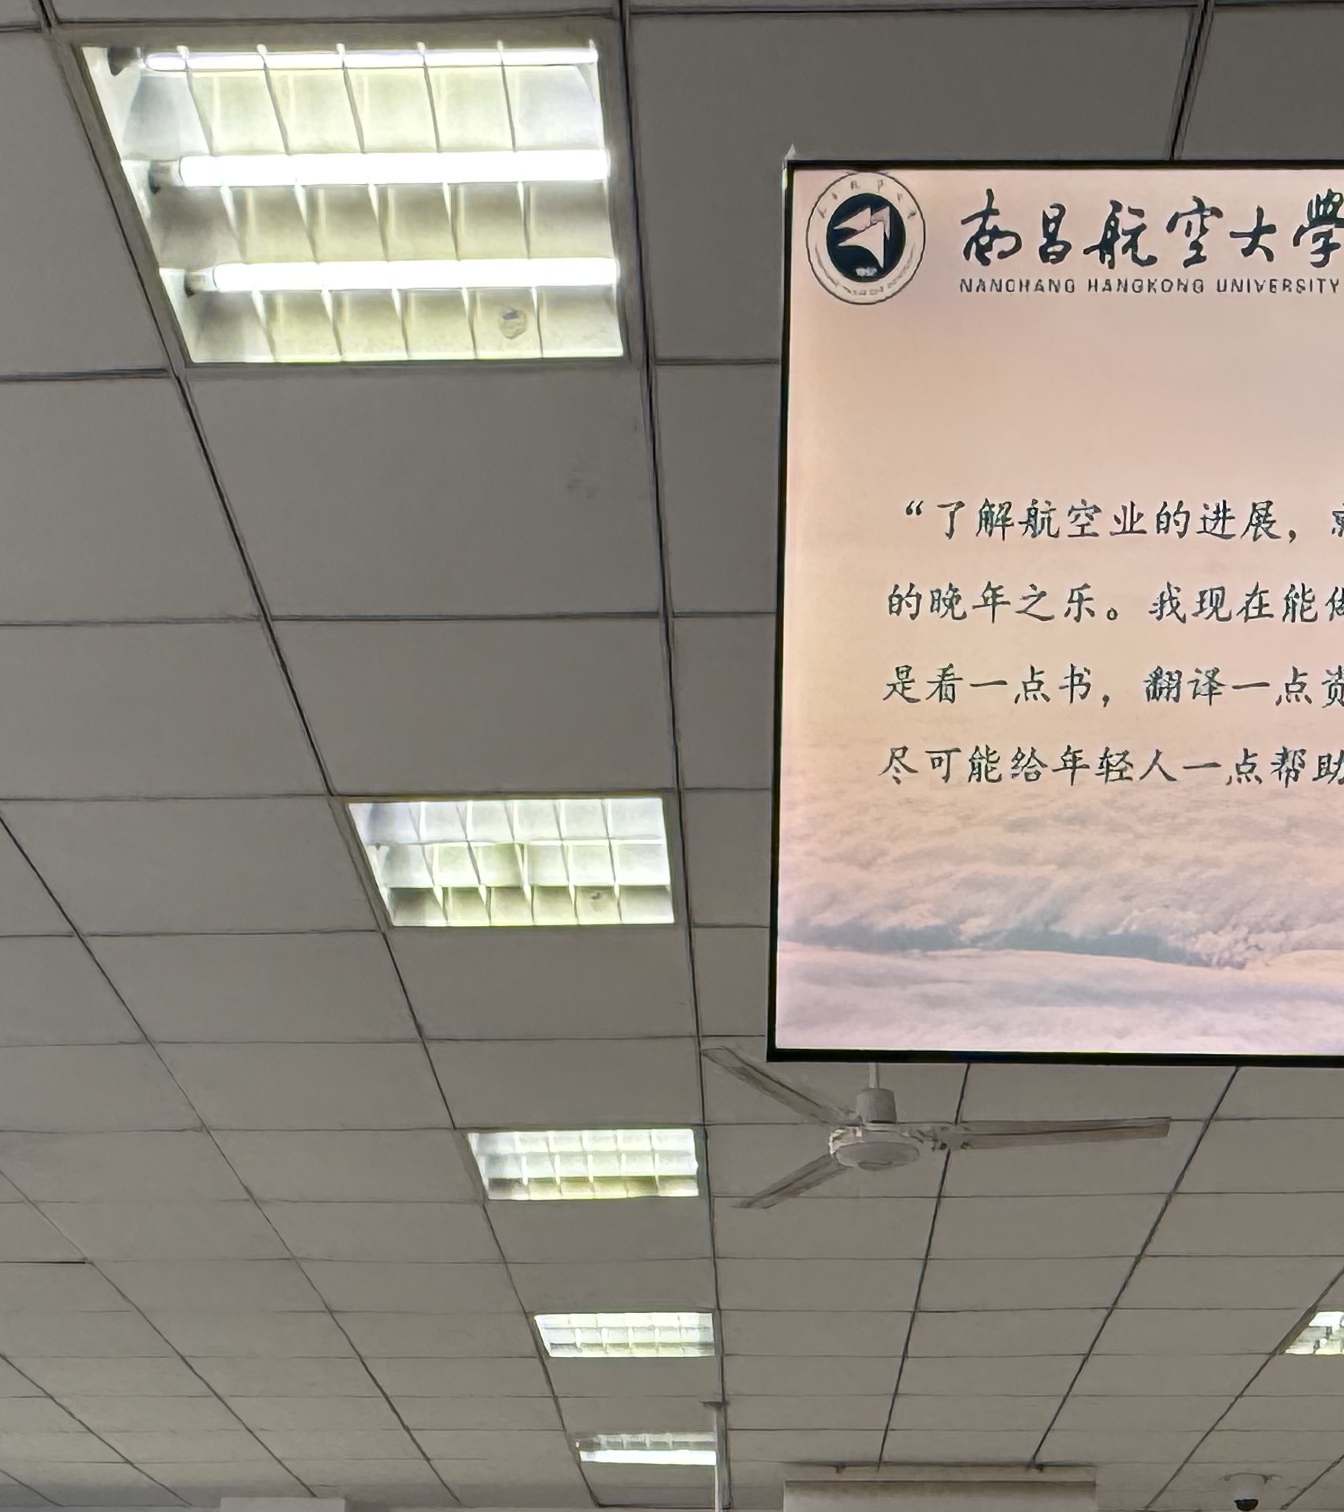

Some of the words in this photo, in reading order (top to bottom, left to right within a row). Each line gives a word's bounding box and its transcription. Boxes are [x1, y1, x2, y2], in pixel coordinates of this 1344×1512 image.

[959, 278, 1075, 294] NANCHANG
[1088, 278, 1205, 294] HANGKONG
[1216, 278, 1340, 294] UNIVERSITY
